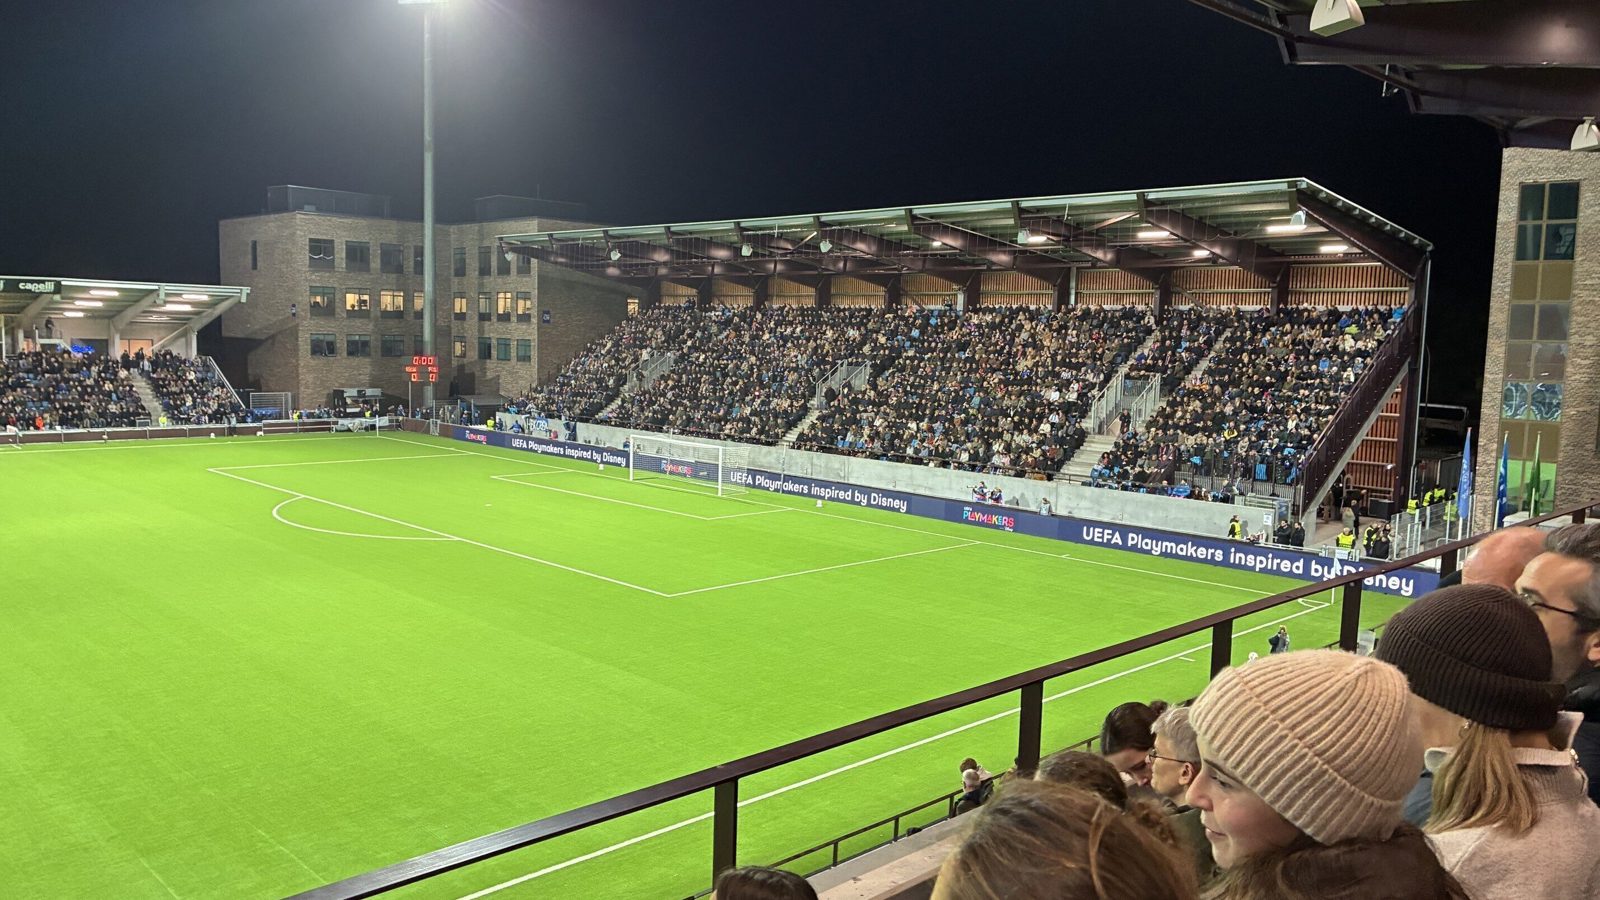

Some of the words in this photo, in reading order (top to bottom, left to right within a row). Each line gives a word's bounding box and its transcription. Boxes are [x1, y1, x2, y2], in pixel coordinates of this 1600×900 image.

[511, 438, 527, 449] UEFA
[528, 440, 564, 454] Playmakers
[565, 446, 591, 459] inspired
[592, 449, 601, 463] by
[602, 452, 626, 467] Disney
[730, 471, 753, 485] UEFA
[755, 475, 808, 494] Playmakers
[811, 483, 851, 500] inspired
[854, 489, 868, 506] by
[870, 493, 907, 513] Disney
[962, 510, 1015, 528] PLAYMAKERS
[1082, 526, 1122, 546] UEFA
[1127, 533, 1223, 562] Playmakers
[1230, 547, 1304, 574] inspired
[1310, 559, 1335, 581] by
[1342, 565, 1414, 597] Dsney
